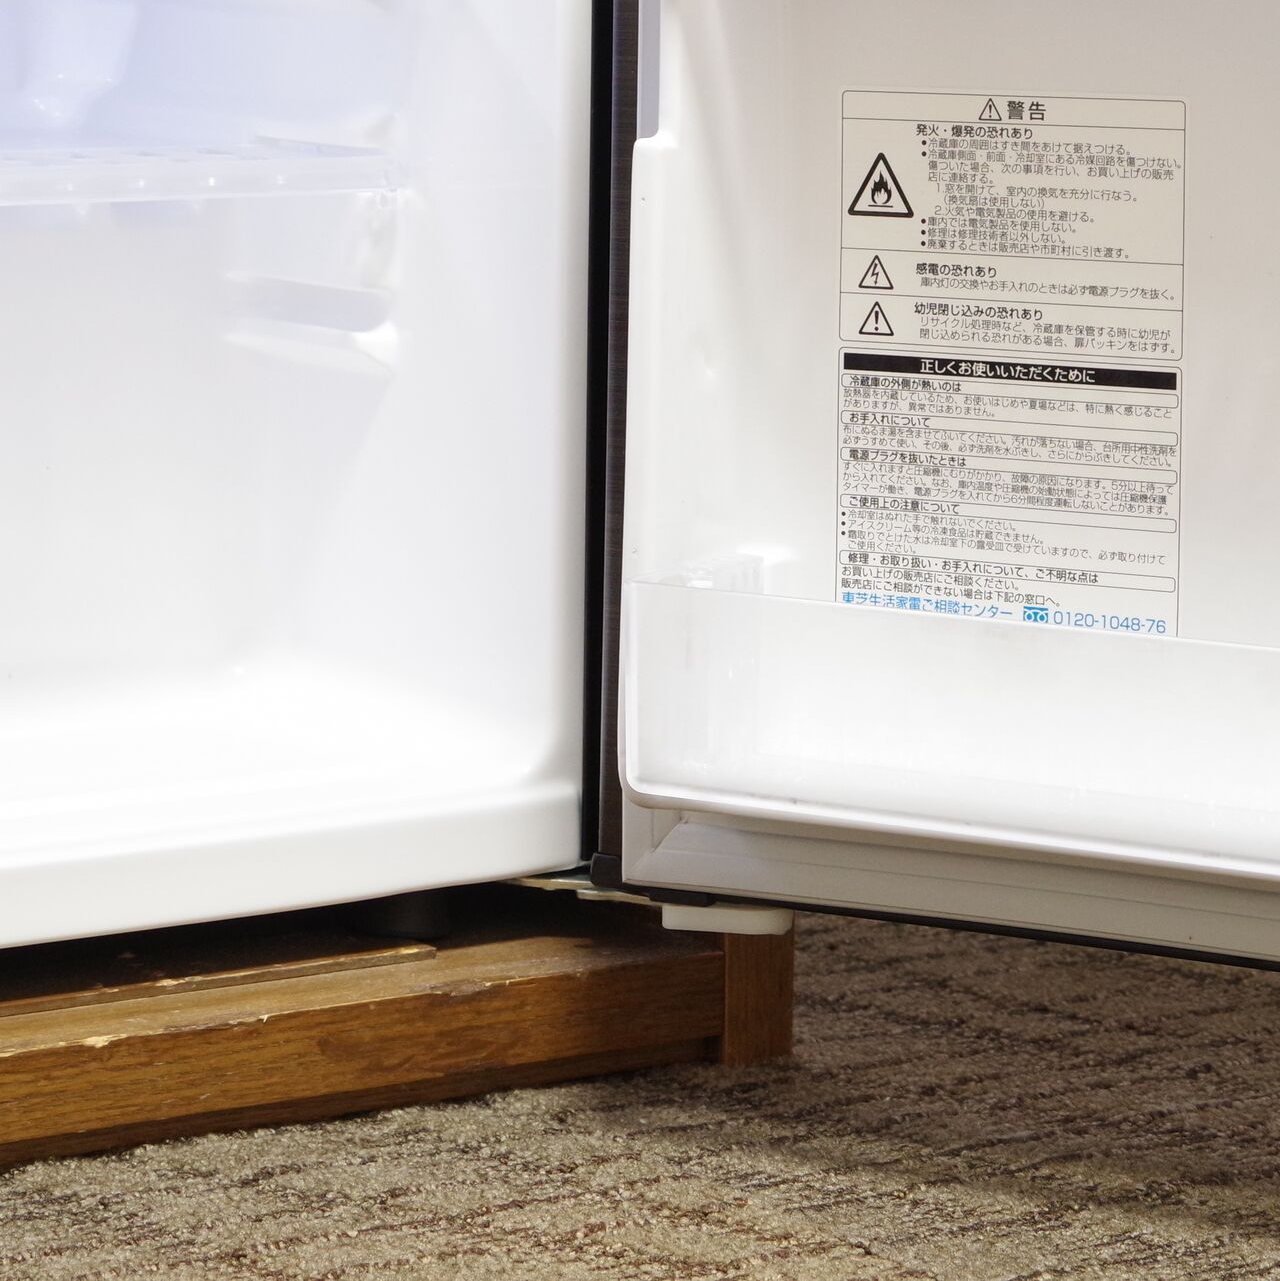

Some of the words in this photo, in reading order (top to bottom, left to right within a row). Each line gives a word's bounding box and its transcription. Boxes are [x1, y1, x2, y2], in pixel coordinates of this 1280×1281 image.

[1007, 101, 1046, 121] 警告
[916, 123, 1033, 140] 発火・爆発の恐れあり
[928, 172, 994, 185] 店に連絡する。
[916, 263, 997, 278] 感電の恐れあり
[914, 302, 1043, 320] 幼児閉じ込みの恐れあり
[920, 359, 1095, 383] 正しくお使いいただくために
[849, 375, 962, 392] 冷蔵庫の外側が熱いのは
[849, 412, 931, 427] お手入れについて
[849, 496, 960, 514] ご使用上の注意について
[1053, 611, 1166, 633] 0120-1048-76
